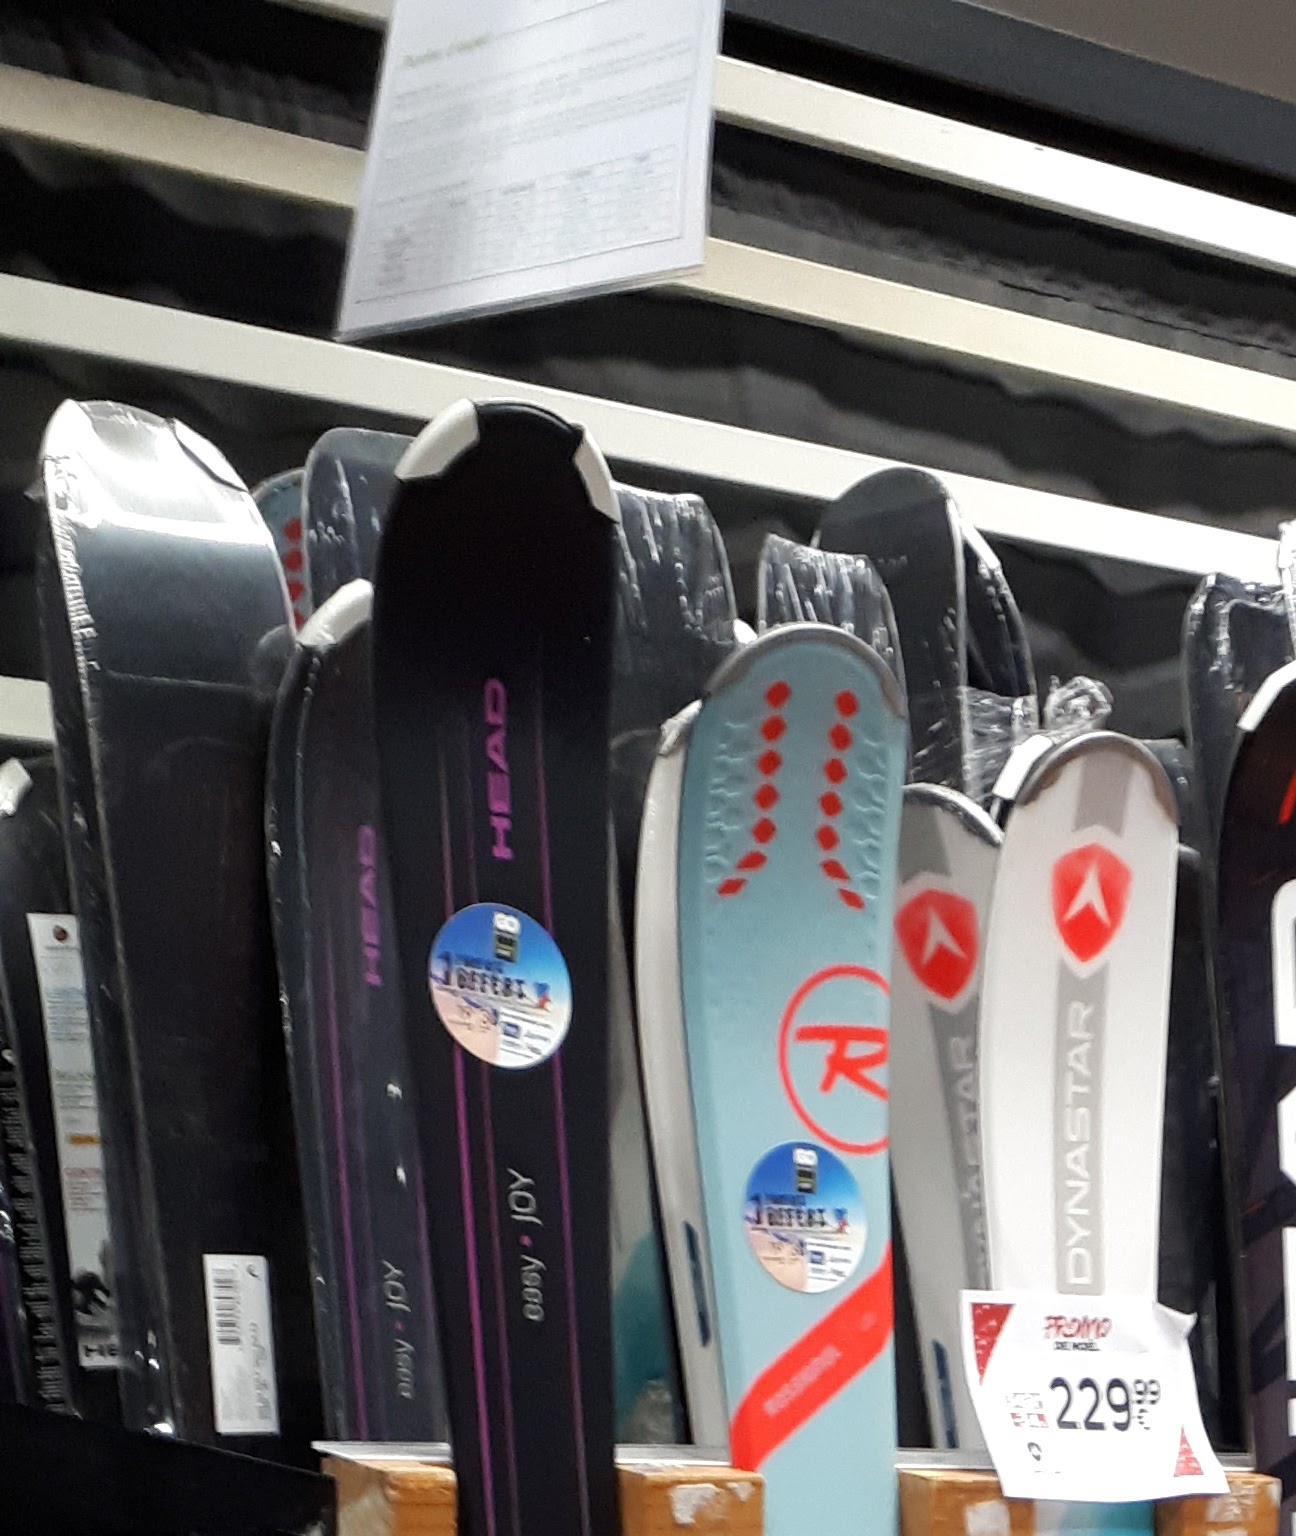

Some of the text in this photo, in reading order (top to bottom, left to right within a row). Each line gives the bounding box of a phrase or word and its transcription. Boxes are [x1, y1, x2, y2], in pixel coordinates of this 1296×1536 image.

[484, 678, 515, 861] HEAD
[357, 824, 384, 987] HEAD
[1062, 1000, 1095, 1286] DYNASTAR
[507, 1167, 544, 1226] JOY
[381, 1259, 412, 1312] JOY
[1044, 1314, 1112, 1340] PROMO
[1049, 1376, 1132, 1432] 229
